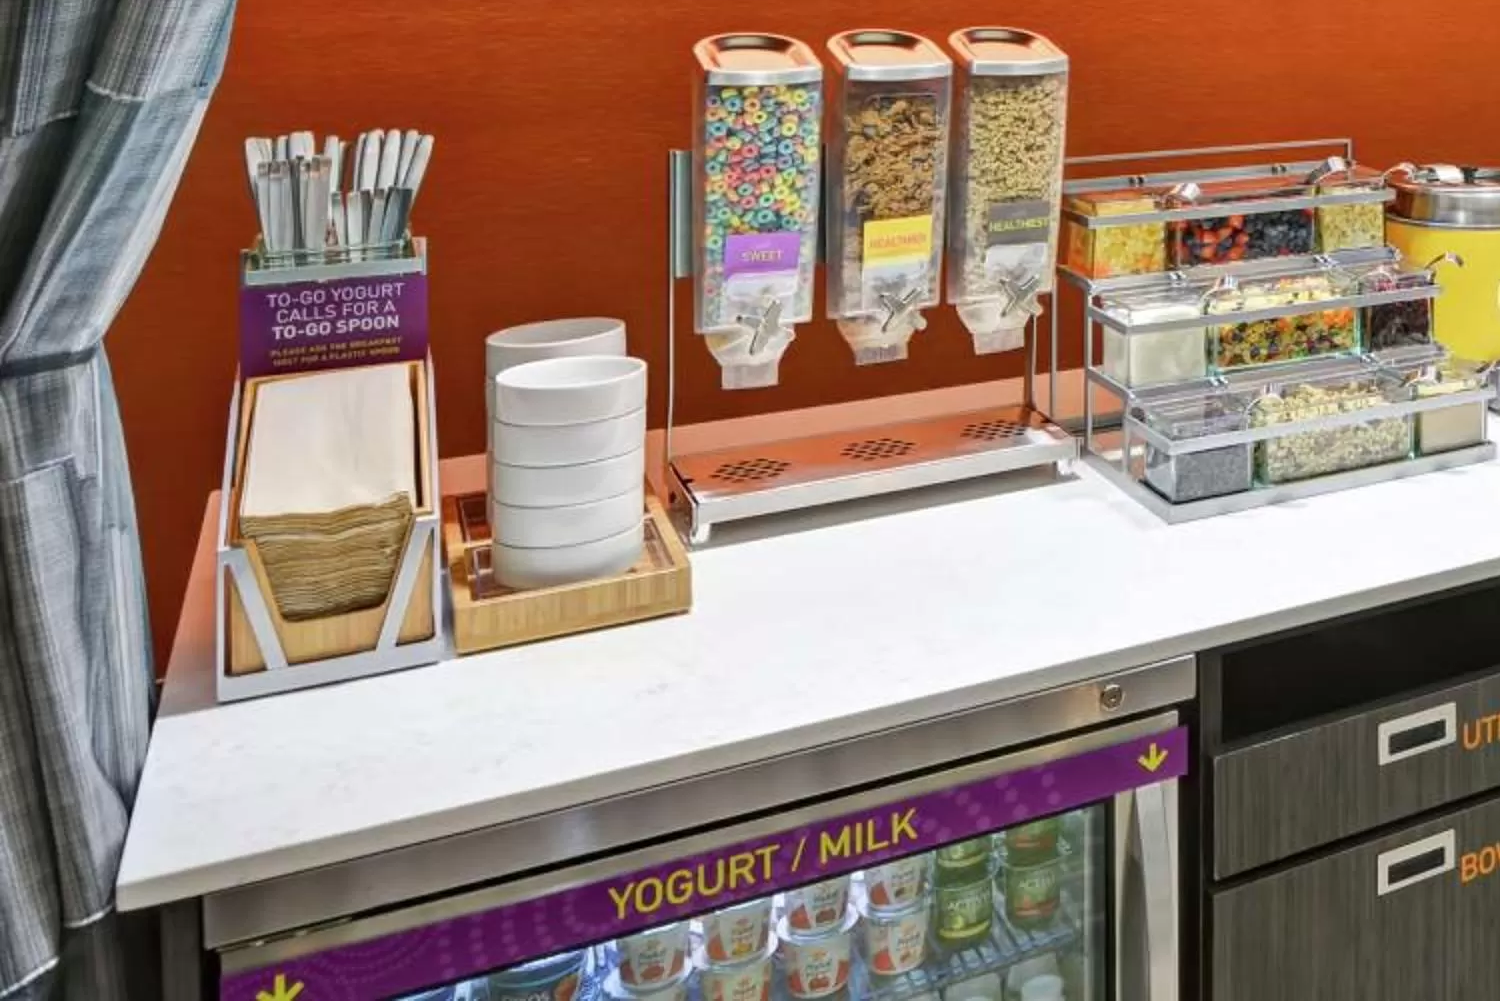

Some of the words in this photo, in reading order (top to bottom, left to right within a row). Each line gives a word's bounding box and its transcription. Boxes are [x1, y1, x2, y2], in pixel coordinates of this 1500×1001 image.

[740, 248, 784, 263] SWEET
[266, 290, 325, 309] TO-GO
[330, 282, 406, 302] YOGURT
[276, 304, 337, 324] CALLS
[342, 300, 379, 317] FOR
[383, 299, 397, 313] A
[271, 321, 331, 340] TO-GO
[335, 314, 400, 335] SPOON
[608, 843, 781, 921] YOGURT
[791, 836, 807, 873] /
[819, 806, 919, 866] MILK
